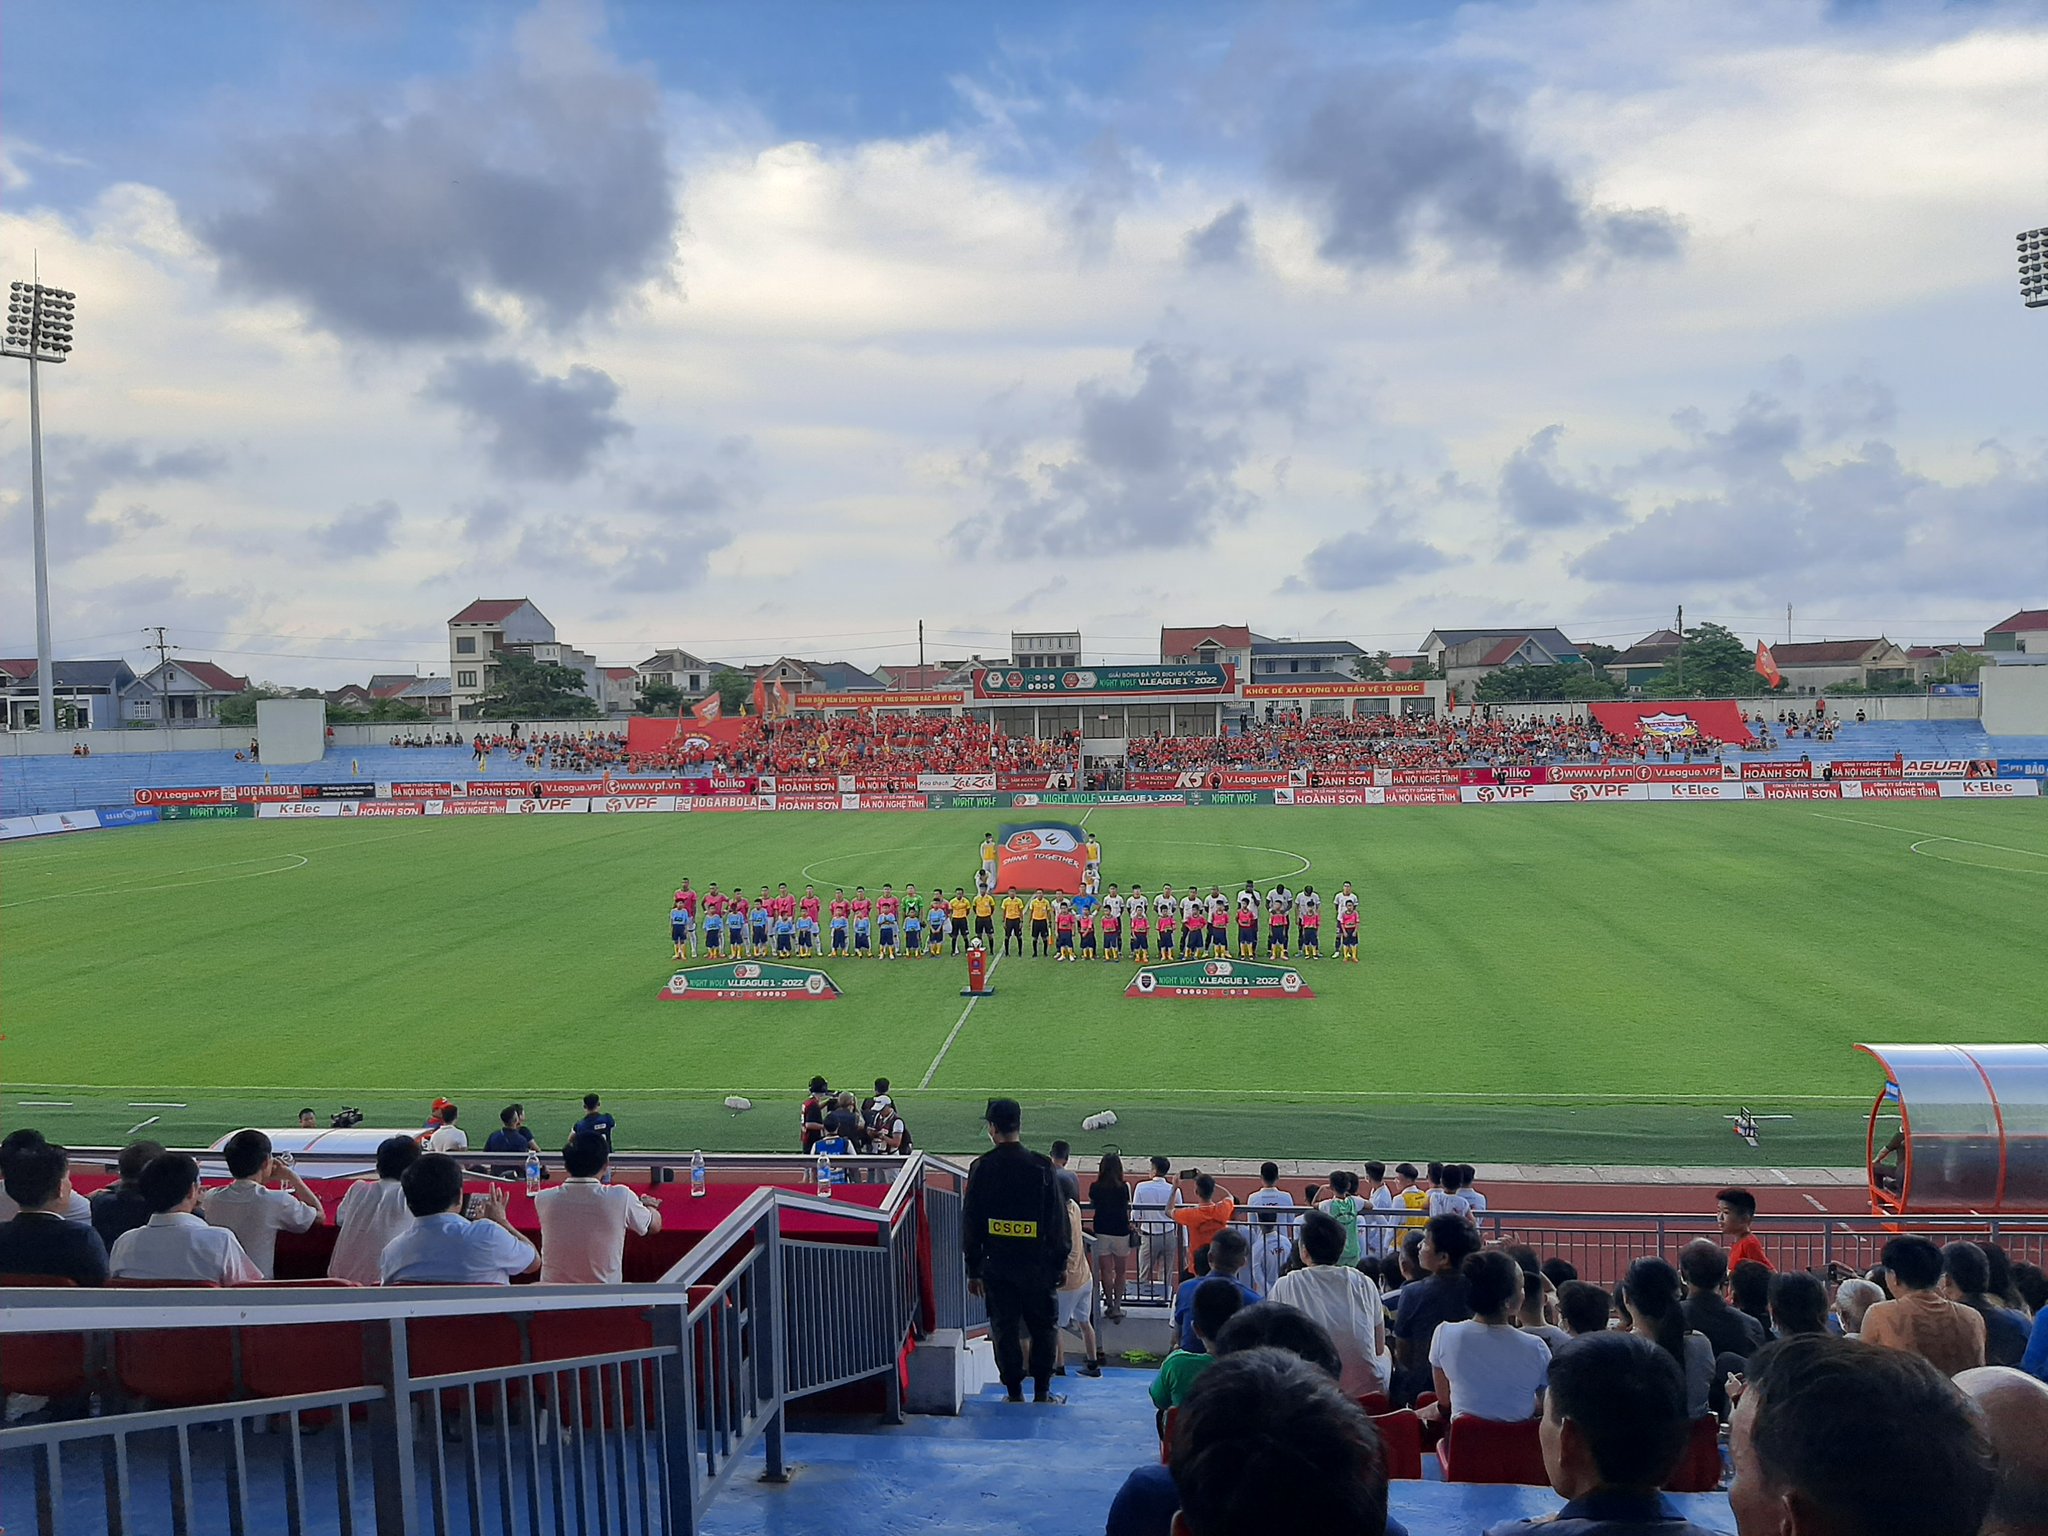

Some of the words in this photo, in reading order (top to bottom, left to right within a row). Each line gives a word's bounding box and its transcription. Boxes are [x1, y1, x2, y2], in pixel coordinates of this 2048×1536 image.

[1905, 761, 1967, 771] AGURI
[1564, 767, 1633, 779] www.vpf.vn
[1656, 767, 1721, 778] V.League.VPF
[710, 779, 746, 789] Noliko
[1174, 772, 1205, 788] K5
[1227, 775, 1287, 785] V.League.VPF
[238, 786, 300, 796] JOGARBOLA
[546, 783, 602, 794] V.League.VPF
[620, 781, 681, 792] www.vpf.vn
[1496, 786, 1534, 798] VPF
[1590, 785, 1629, 796] VPF
[1672, 784, 1719, 795] K-Elec
[1963, 782, 2013, 792] K-Elec
[156, 790, 219, 800] V.League.VPF
[1043, 794, 1069, 804] NIGHT
[1072, 794, 1096, 803] WOLF
[1212, 794, 1233, 804] NIGHT
[1236, 794, 1258, 803] WOLF
[539, 799, 572, 810] VPF
[624, 798, 657, 809] VPF
[693, 797, 757, 808] JOGARBOLA
[953, 797, 975, 808] NIGHT
[977, 797, 997, 807] WOLF
[190, 807, 214, 816] NIGHT
[217, 807, 239, 816] WOLF
[279, 804, 321, 814] K-Elec
[1033, 853, 1080, 869] TOGETHER
[993, 1221, 1032, 1234] CSCĐ
